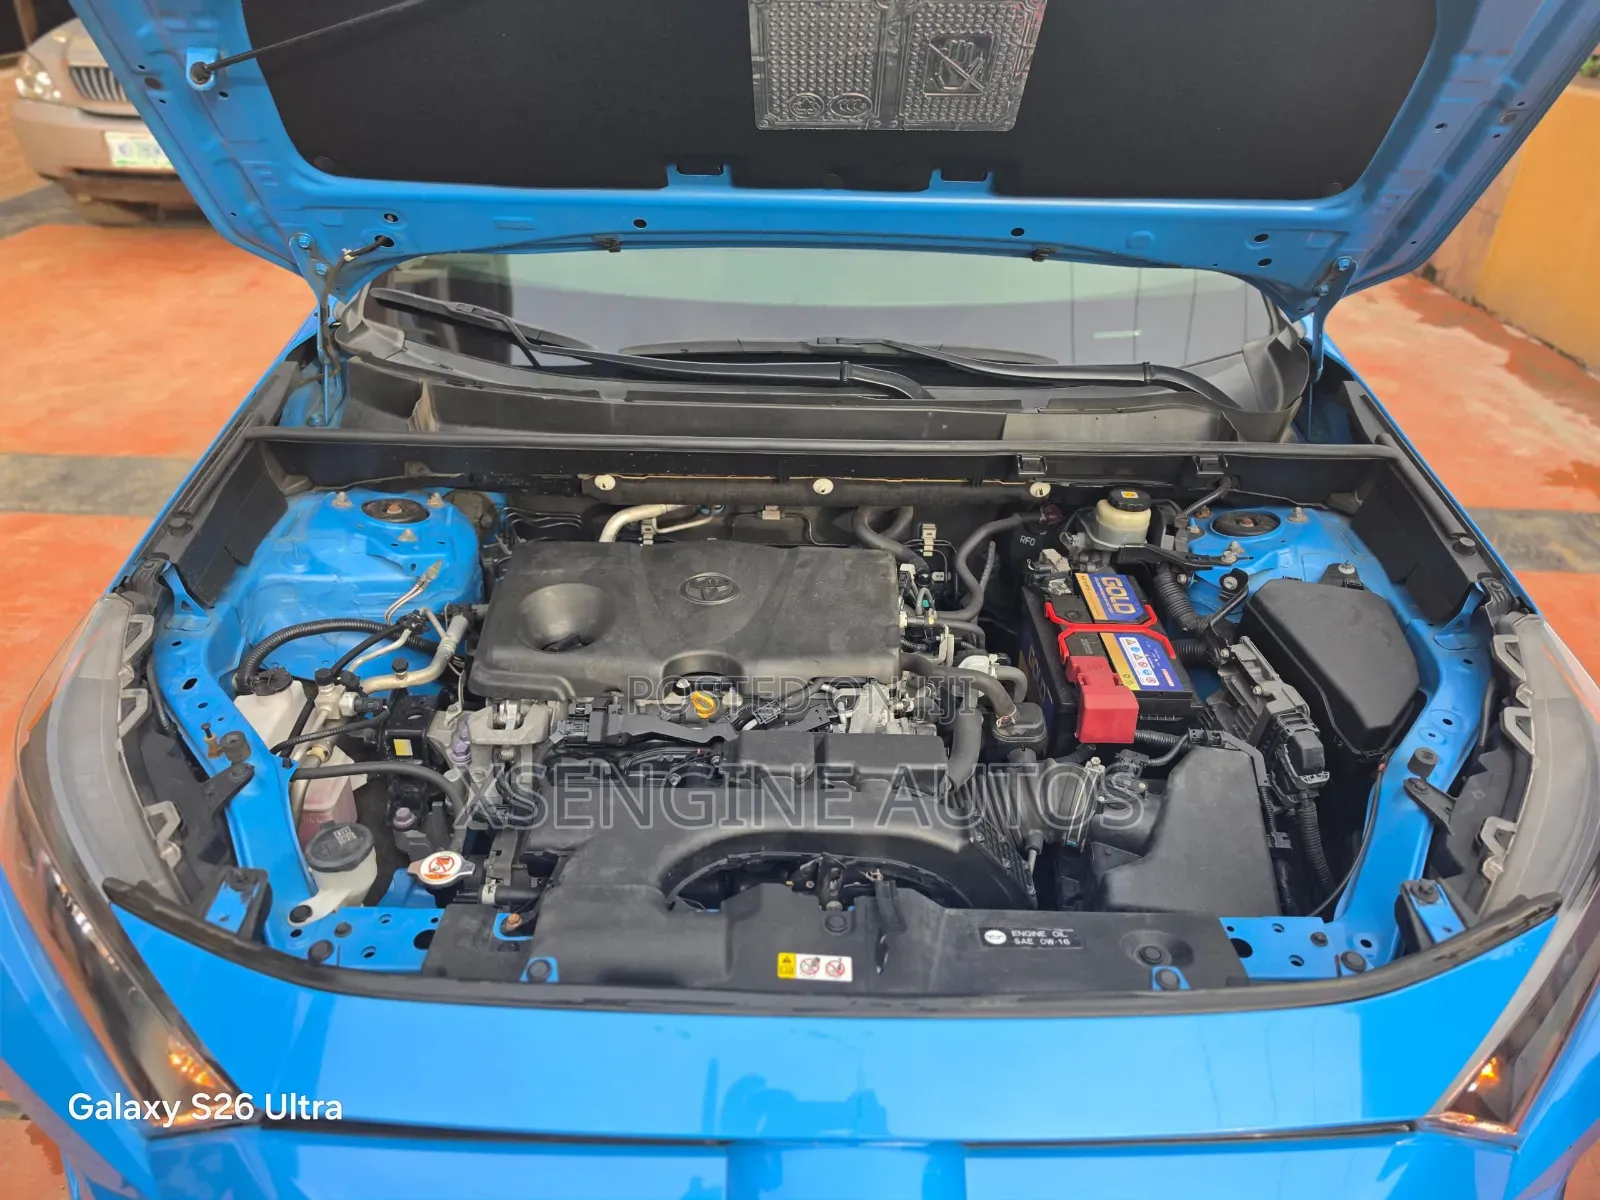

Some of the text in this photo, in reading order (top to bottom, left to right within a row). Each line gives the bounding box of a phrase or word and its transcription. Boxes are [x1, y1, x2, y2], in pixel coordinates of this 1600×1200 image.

[1101, 575, 1136, 615] GOLD
[1011, 930, 1069, 938] ENGINE OIL
